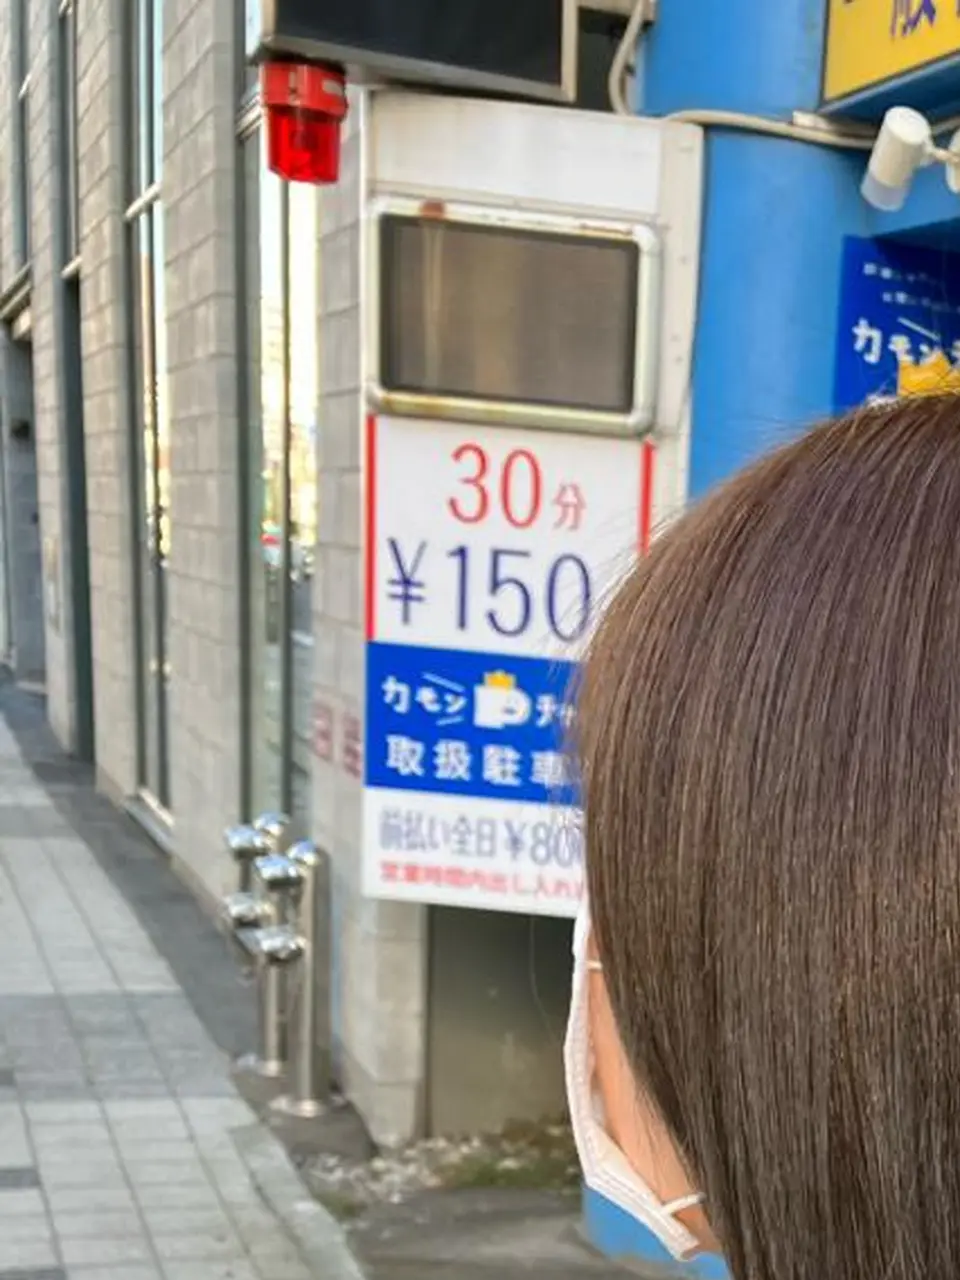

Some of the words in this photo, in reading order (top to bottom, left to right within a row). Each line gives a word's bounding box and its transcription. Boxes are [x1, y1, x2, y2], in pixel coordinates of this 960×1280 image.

[449, 442, 587, 532] 30分
[386, 536, 592, 643] ¥150
[385, 734, 571, 788] 取扱駐車
[379, 806, 582, 868] 前払い全日¥80
